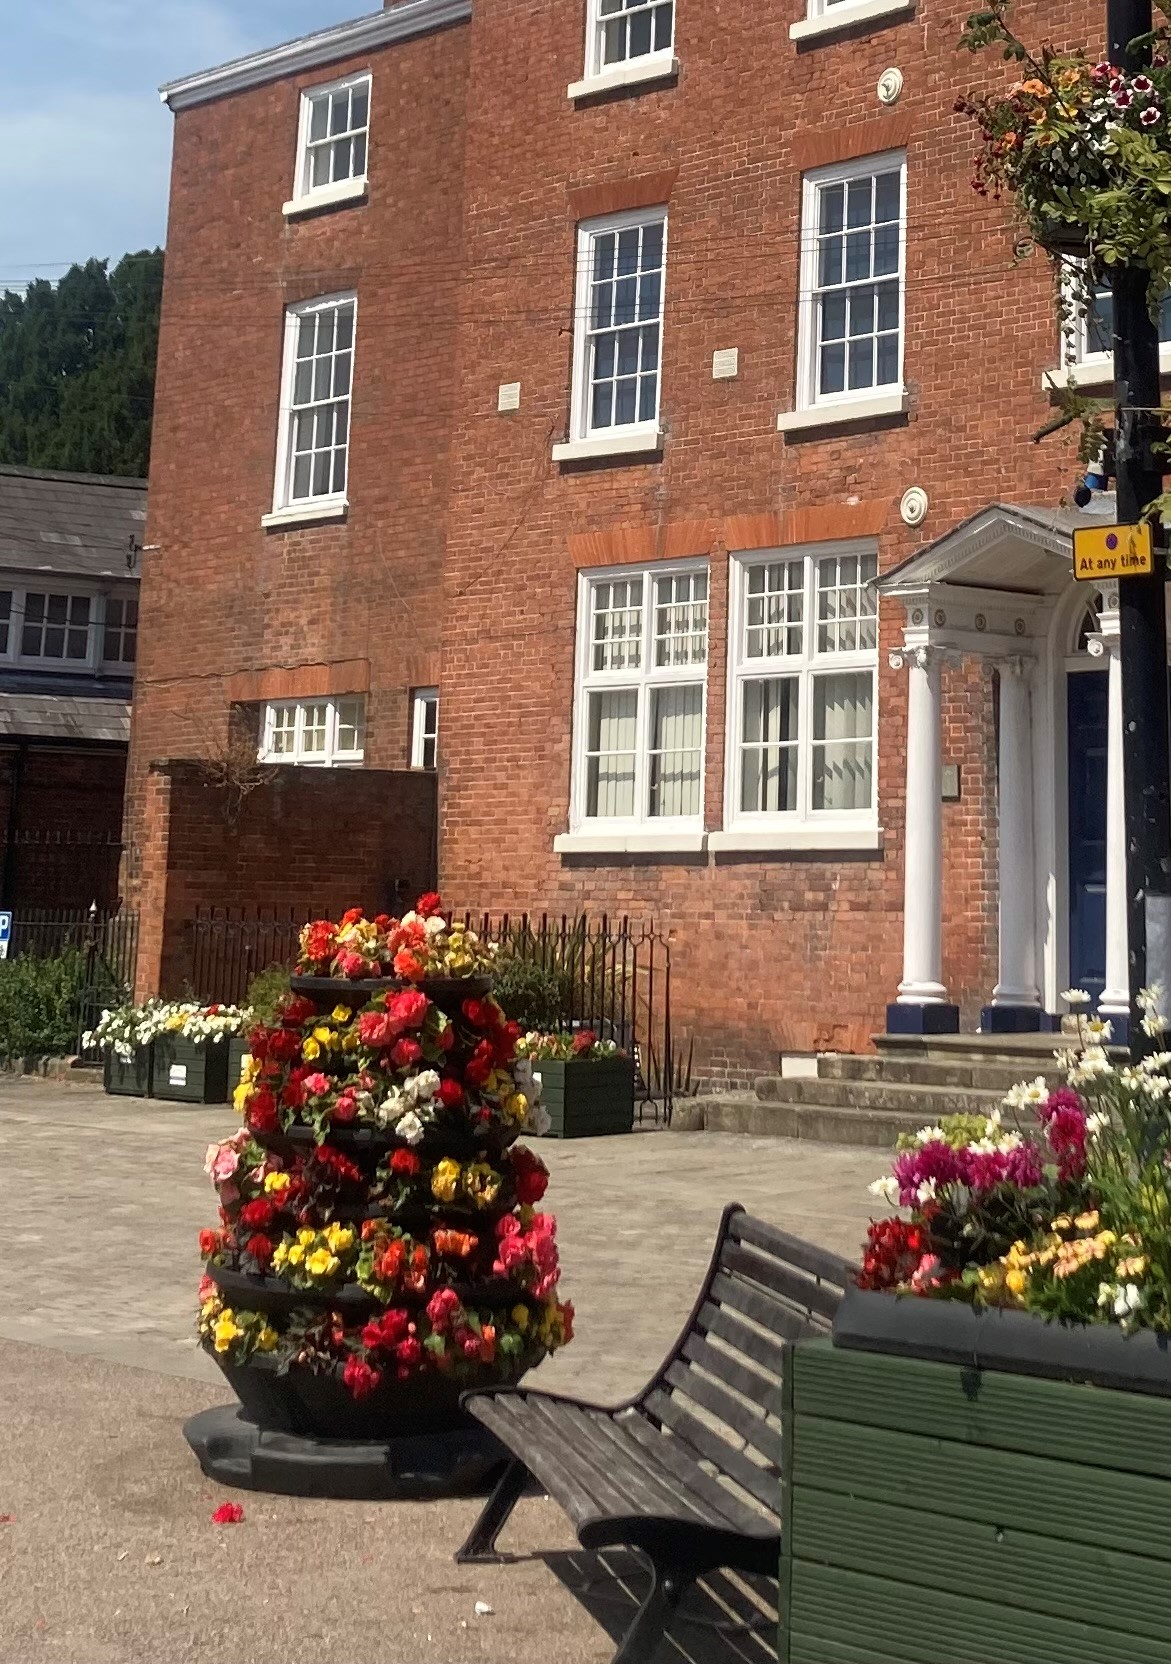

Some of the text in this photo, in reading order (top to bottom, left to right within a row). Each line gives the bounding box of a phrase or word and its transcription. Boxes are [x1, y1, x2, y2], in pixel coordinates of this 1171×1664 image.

[1080, 554, 1146, 571] At any time
